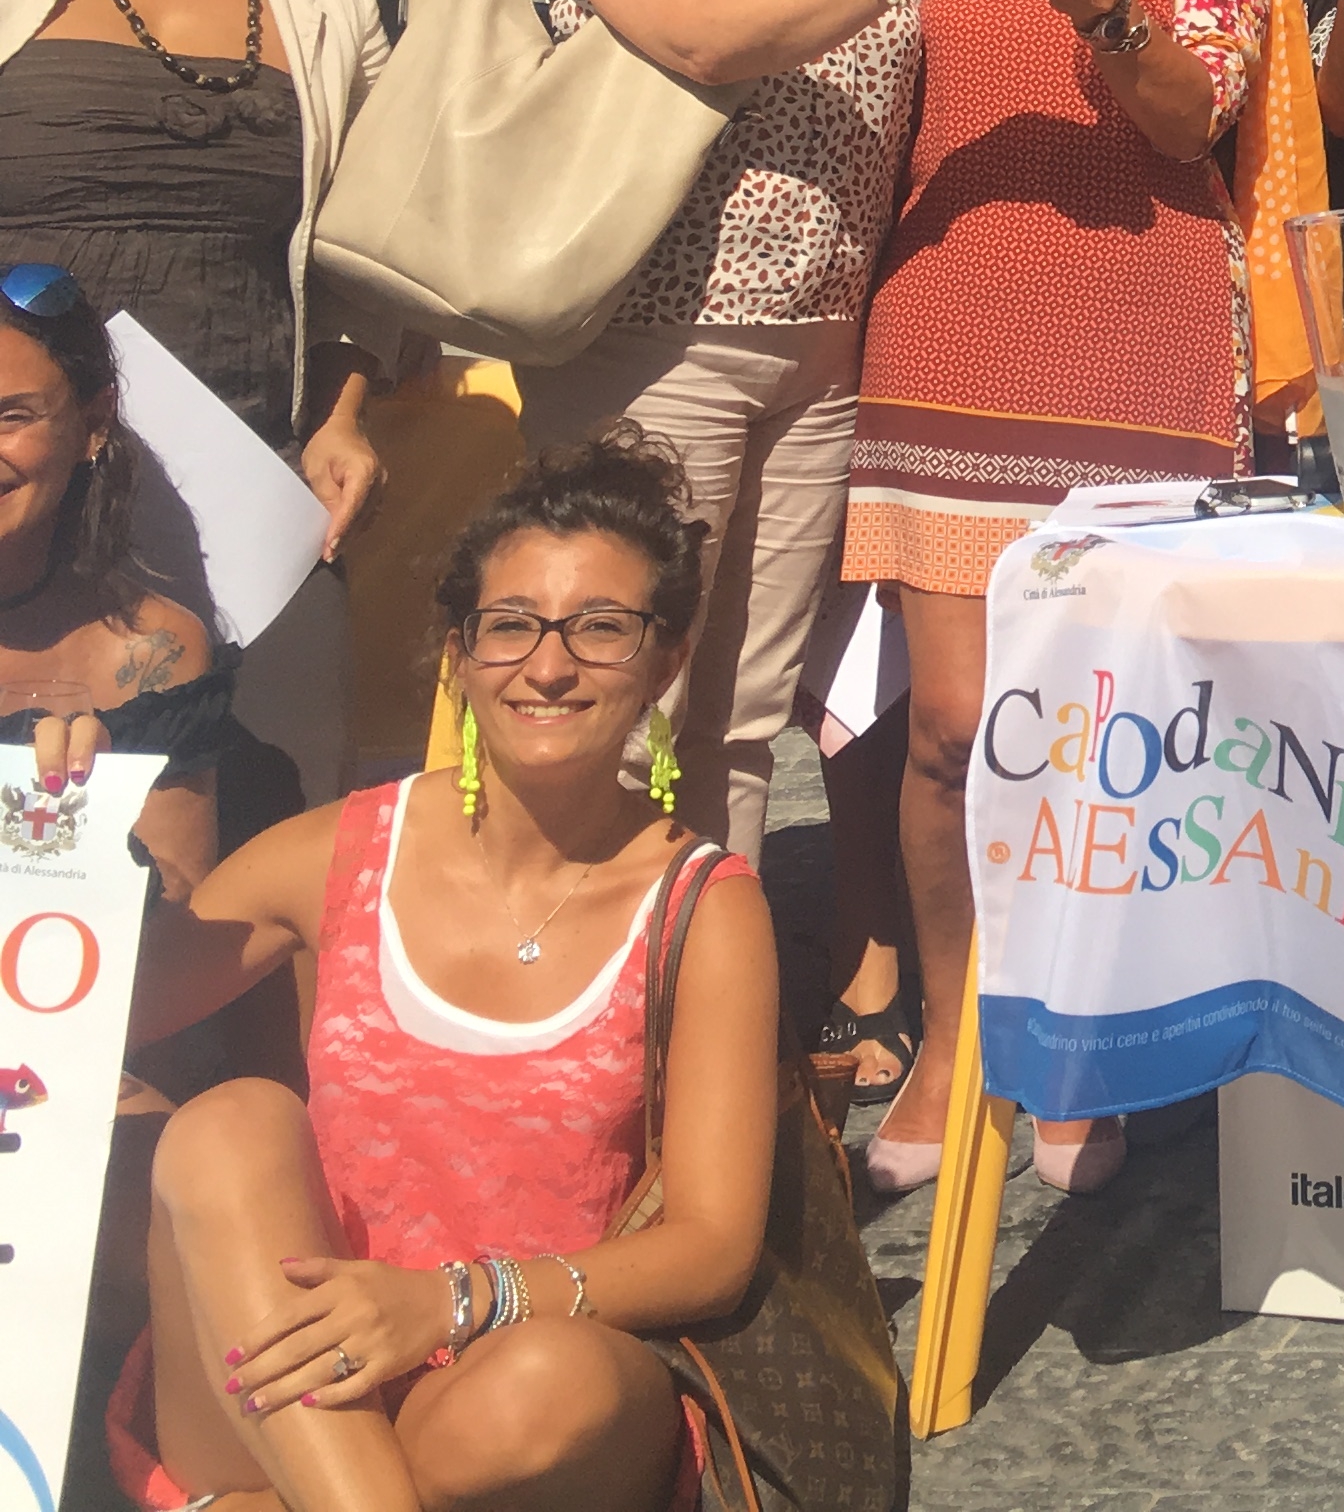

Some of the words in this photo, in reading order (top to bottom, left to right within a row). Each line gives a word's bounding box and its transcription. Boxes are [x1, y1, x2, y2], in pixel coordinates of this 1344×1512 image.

[11, 863, 21, 874] di
[23, 865, 87, 880] Alessandria
[1081, 1032, 1114, 1052] vinci
[1116, 1026, 1148, 1048] cene
[1151, 1029, 1160, 1043] e
[1271, 999, 1281, 1013] il
[1282, 1002, 1301, 1024] tuo
